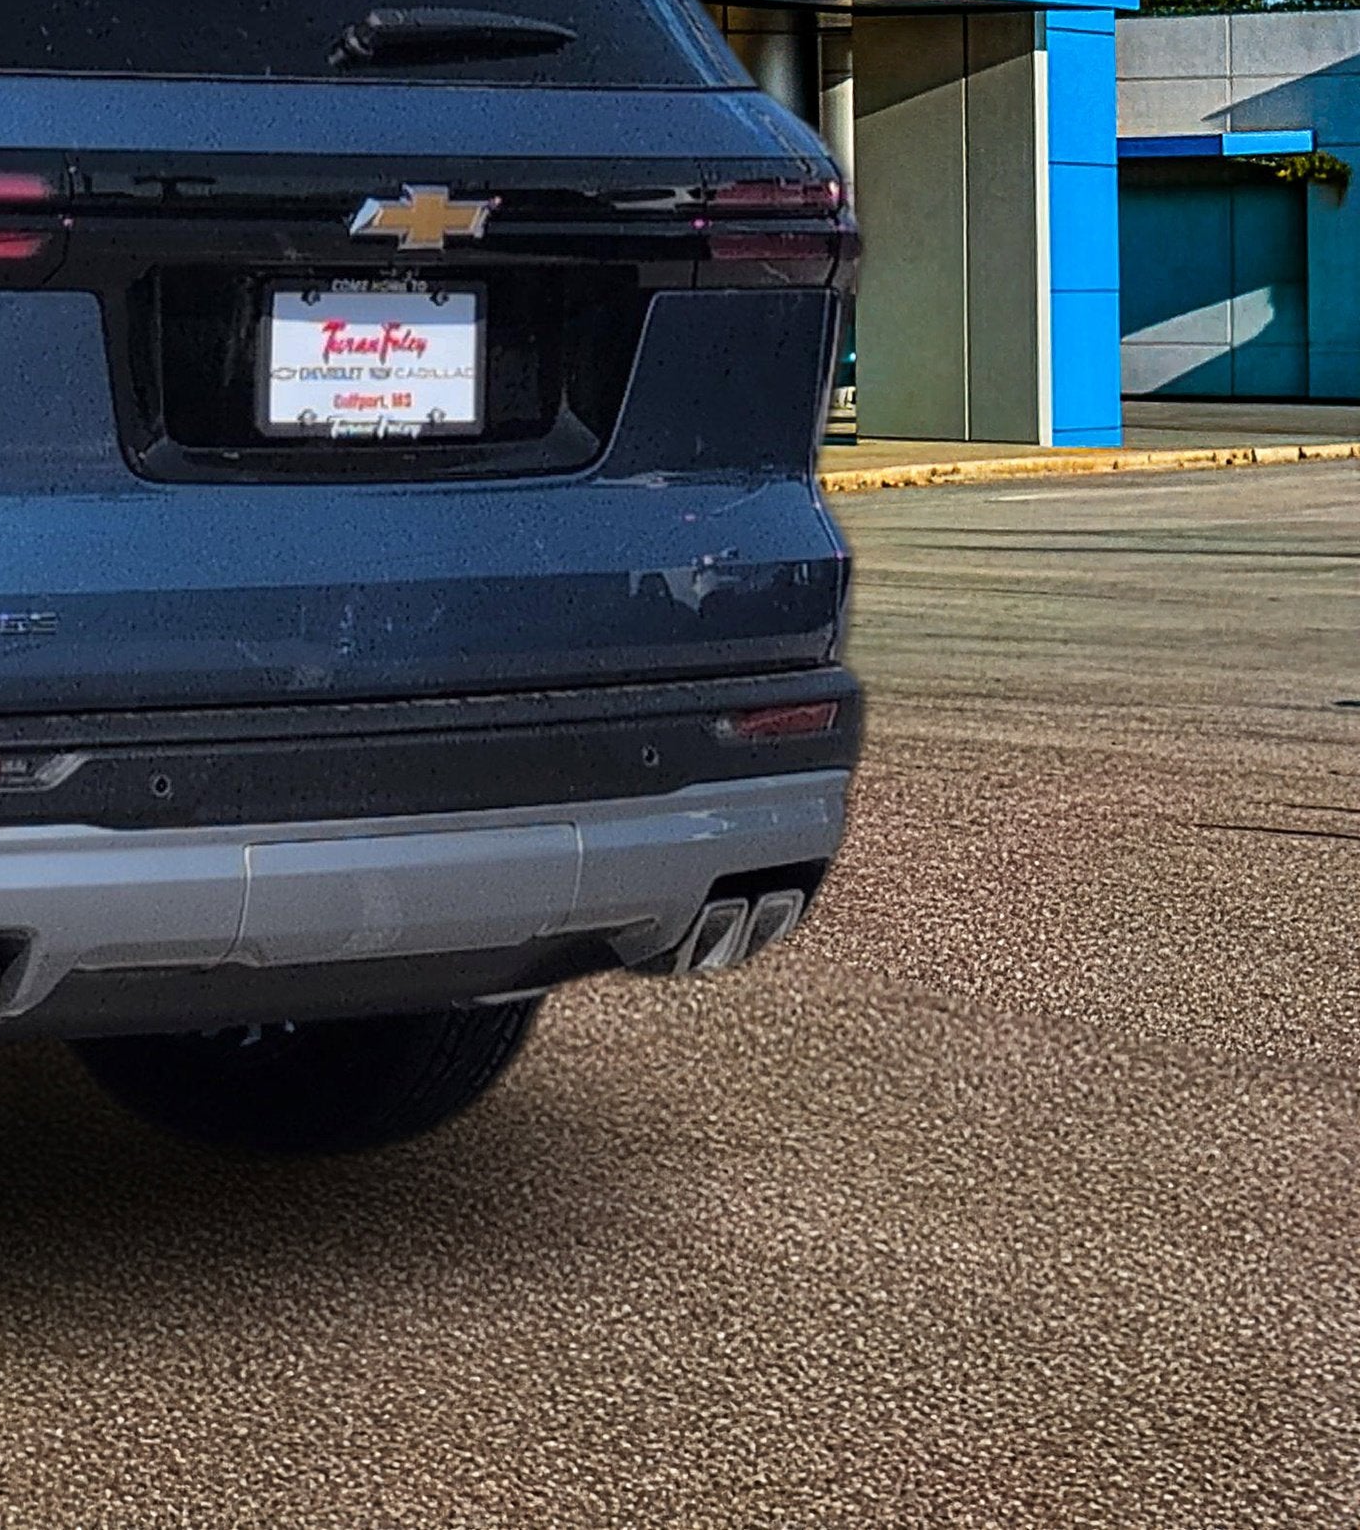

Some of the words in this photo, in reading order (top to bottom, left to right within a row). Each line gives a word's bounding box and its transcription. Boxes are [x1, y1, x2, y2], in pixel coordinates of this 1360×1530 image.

[322, 320, 381, 364] Turan
[380, 321, 429, 365] Foley
[393, 367, 474, 380] CADILLAC
